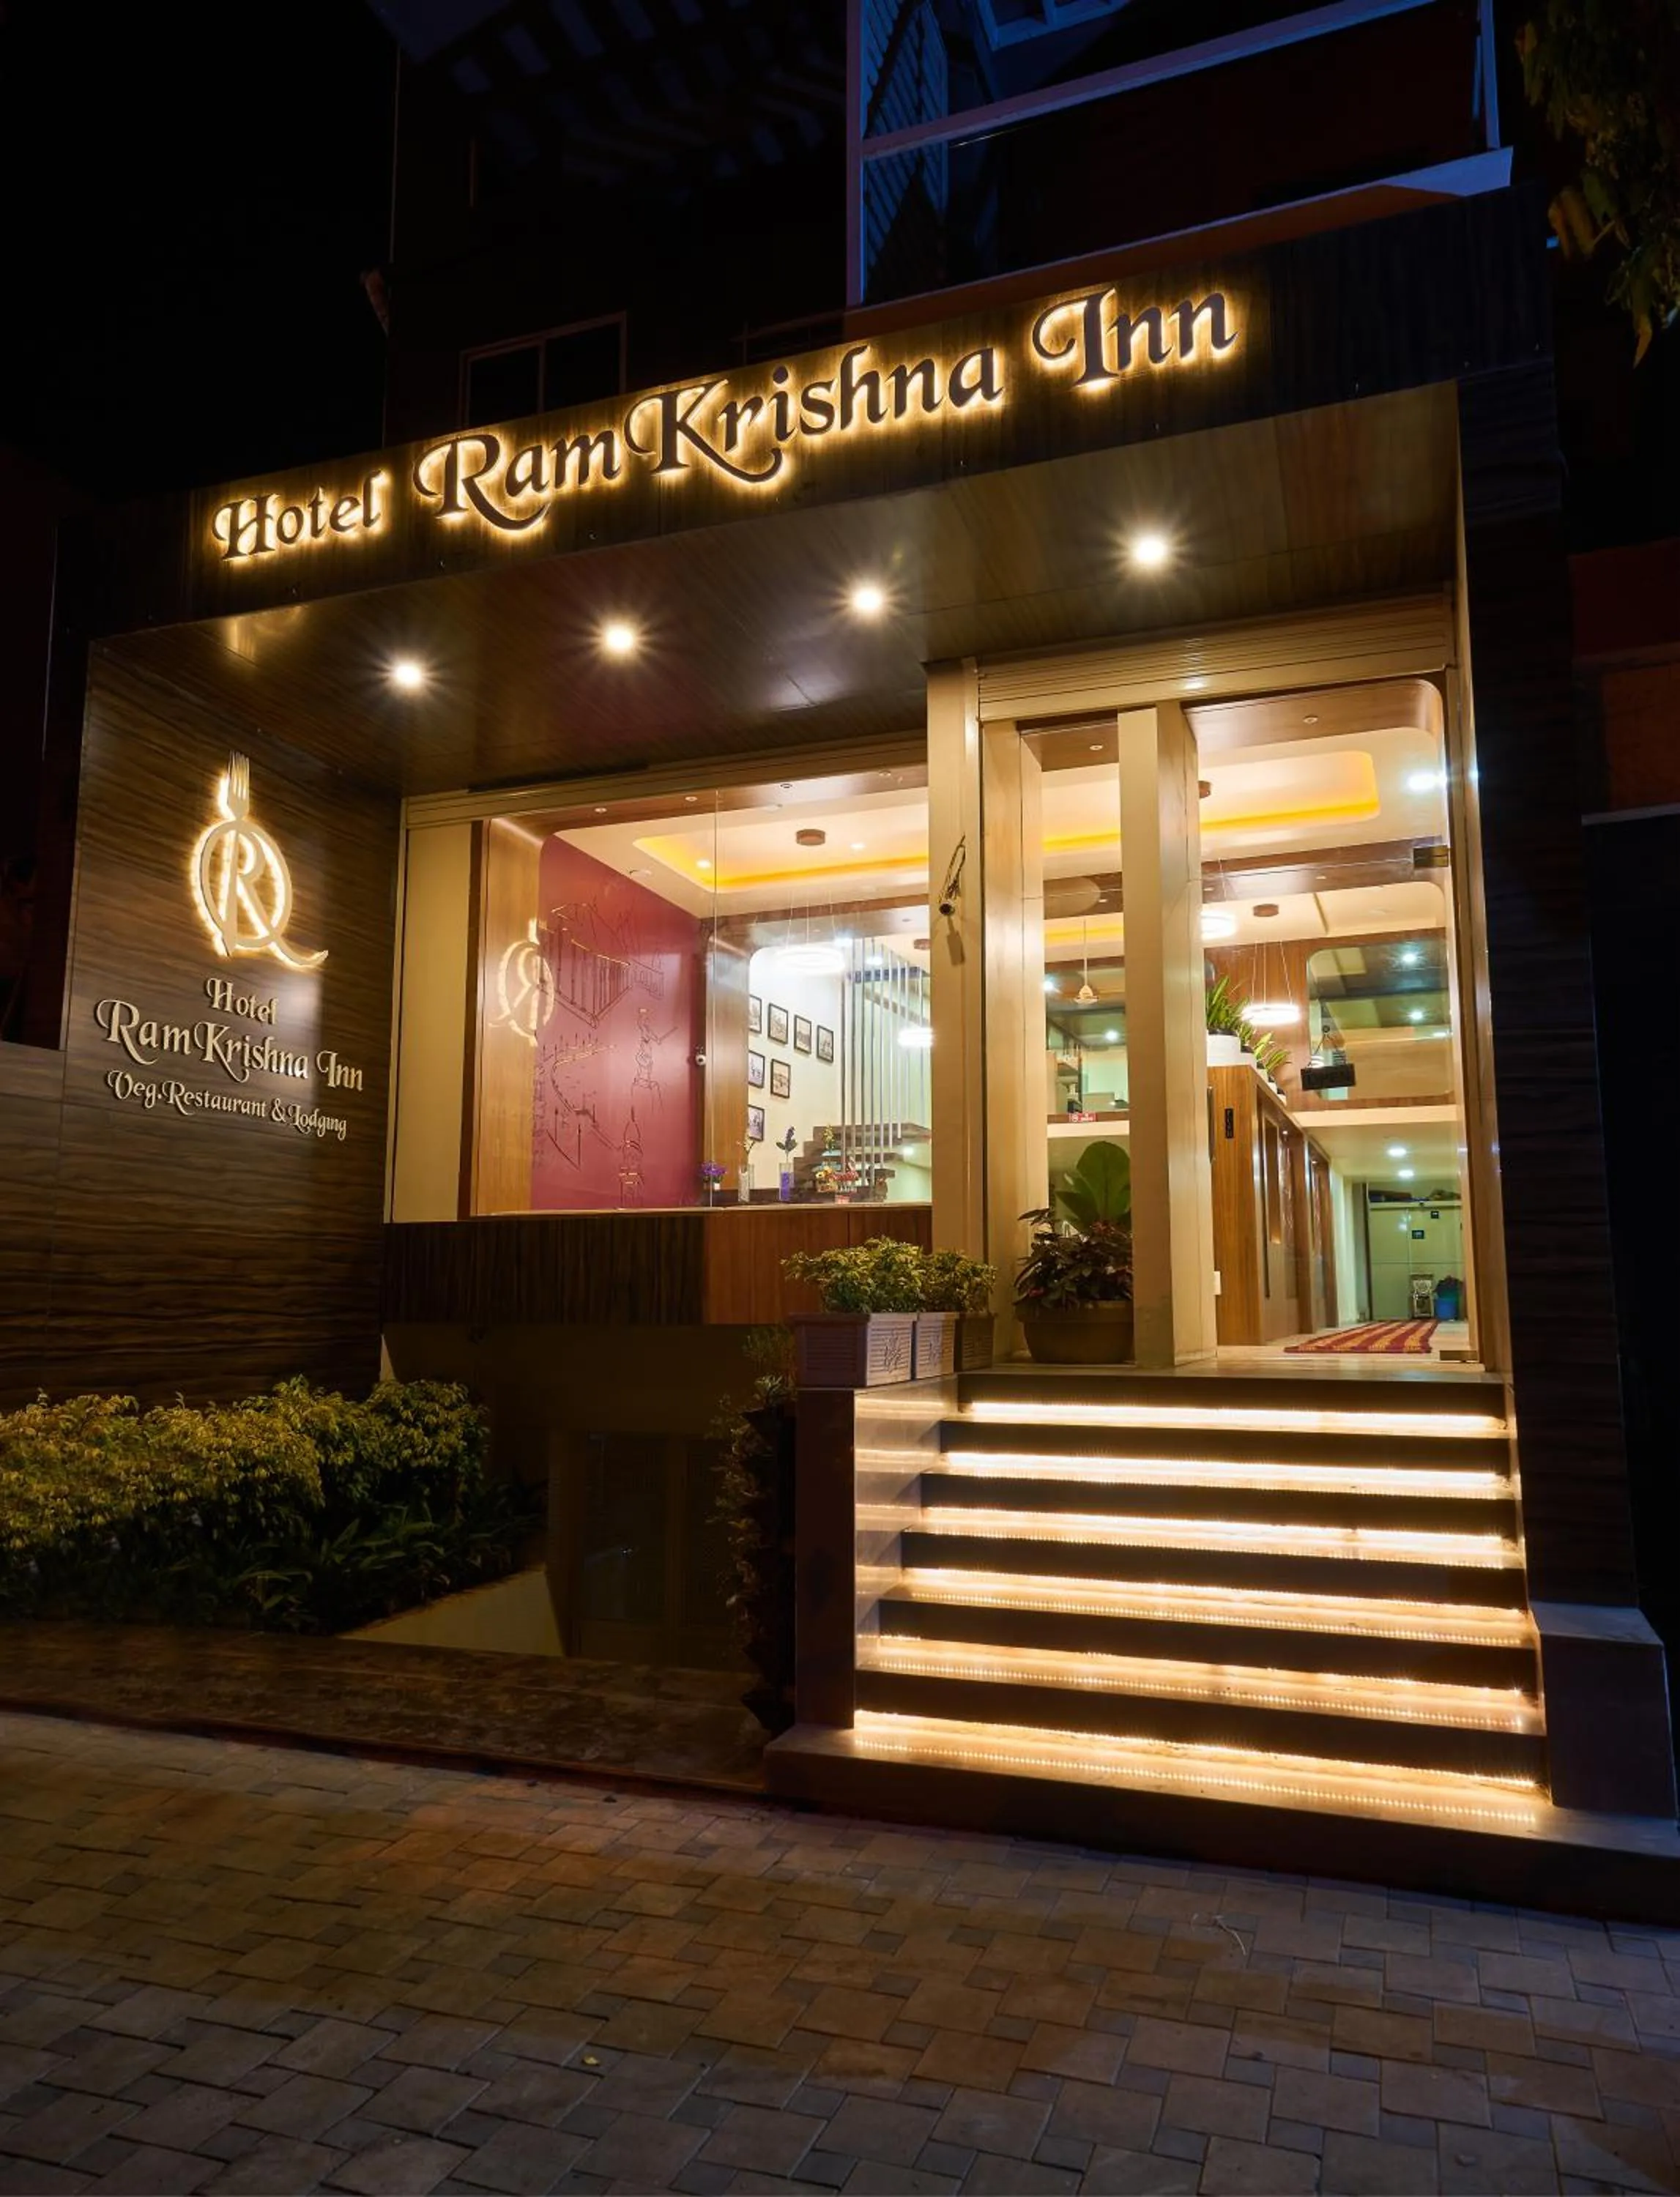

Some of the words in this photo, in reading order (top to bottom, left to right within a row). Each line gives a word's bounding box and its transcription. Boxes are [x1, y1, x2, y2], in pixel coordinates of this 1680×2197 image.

[212, 469, 384, 561] Hotel
[1032, 288, 1238, 388] Inn
[207, 978, 278, 1025] Hotel
[316, 1049, 364, 1091] Inn
